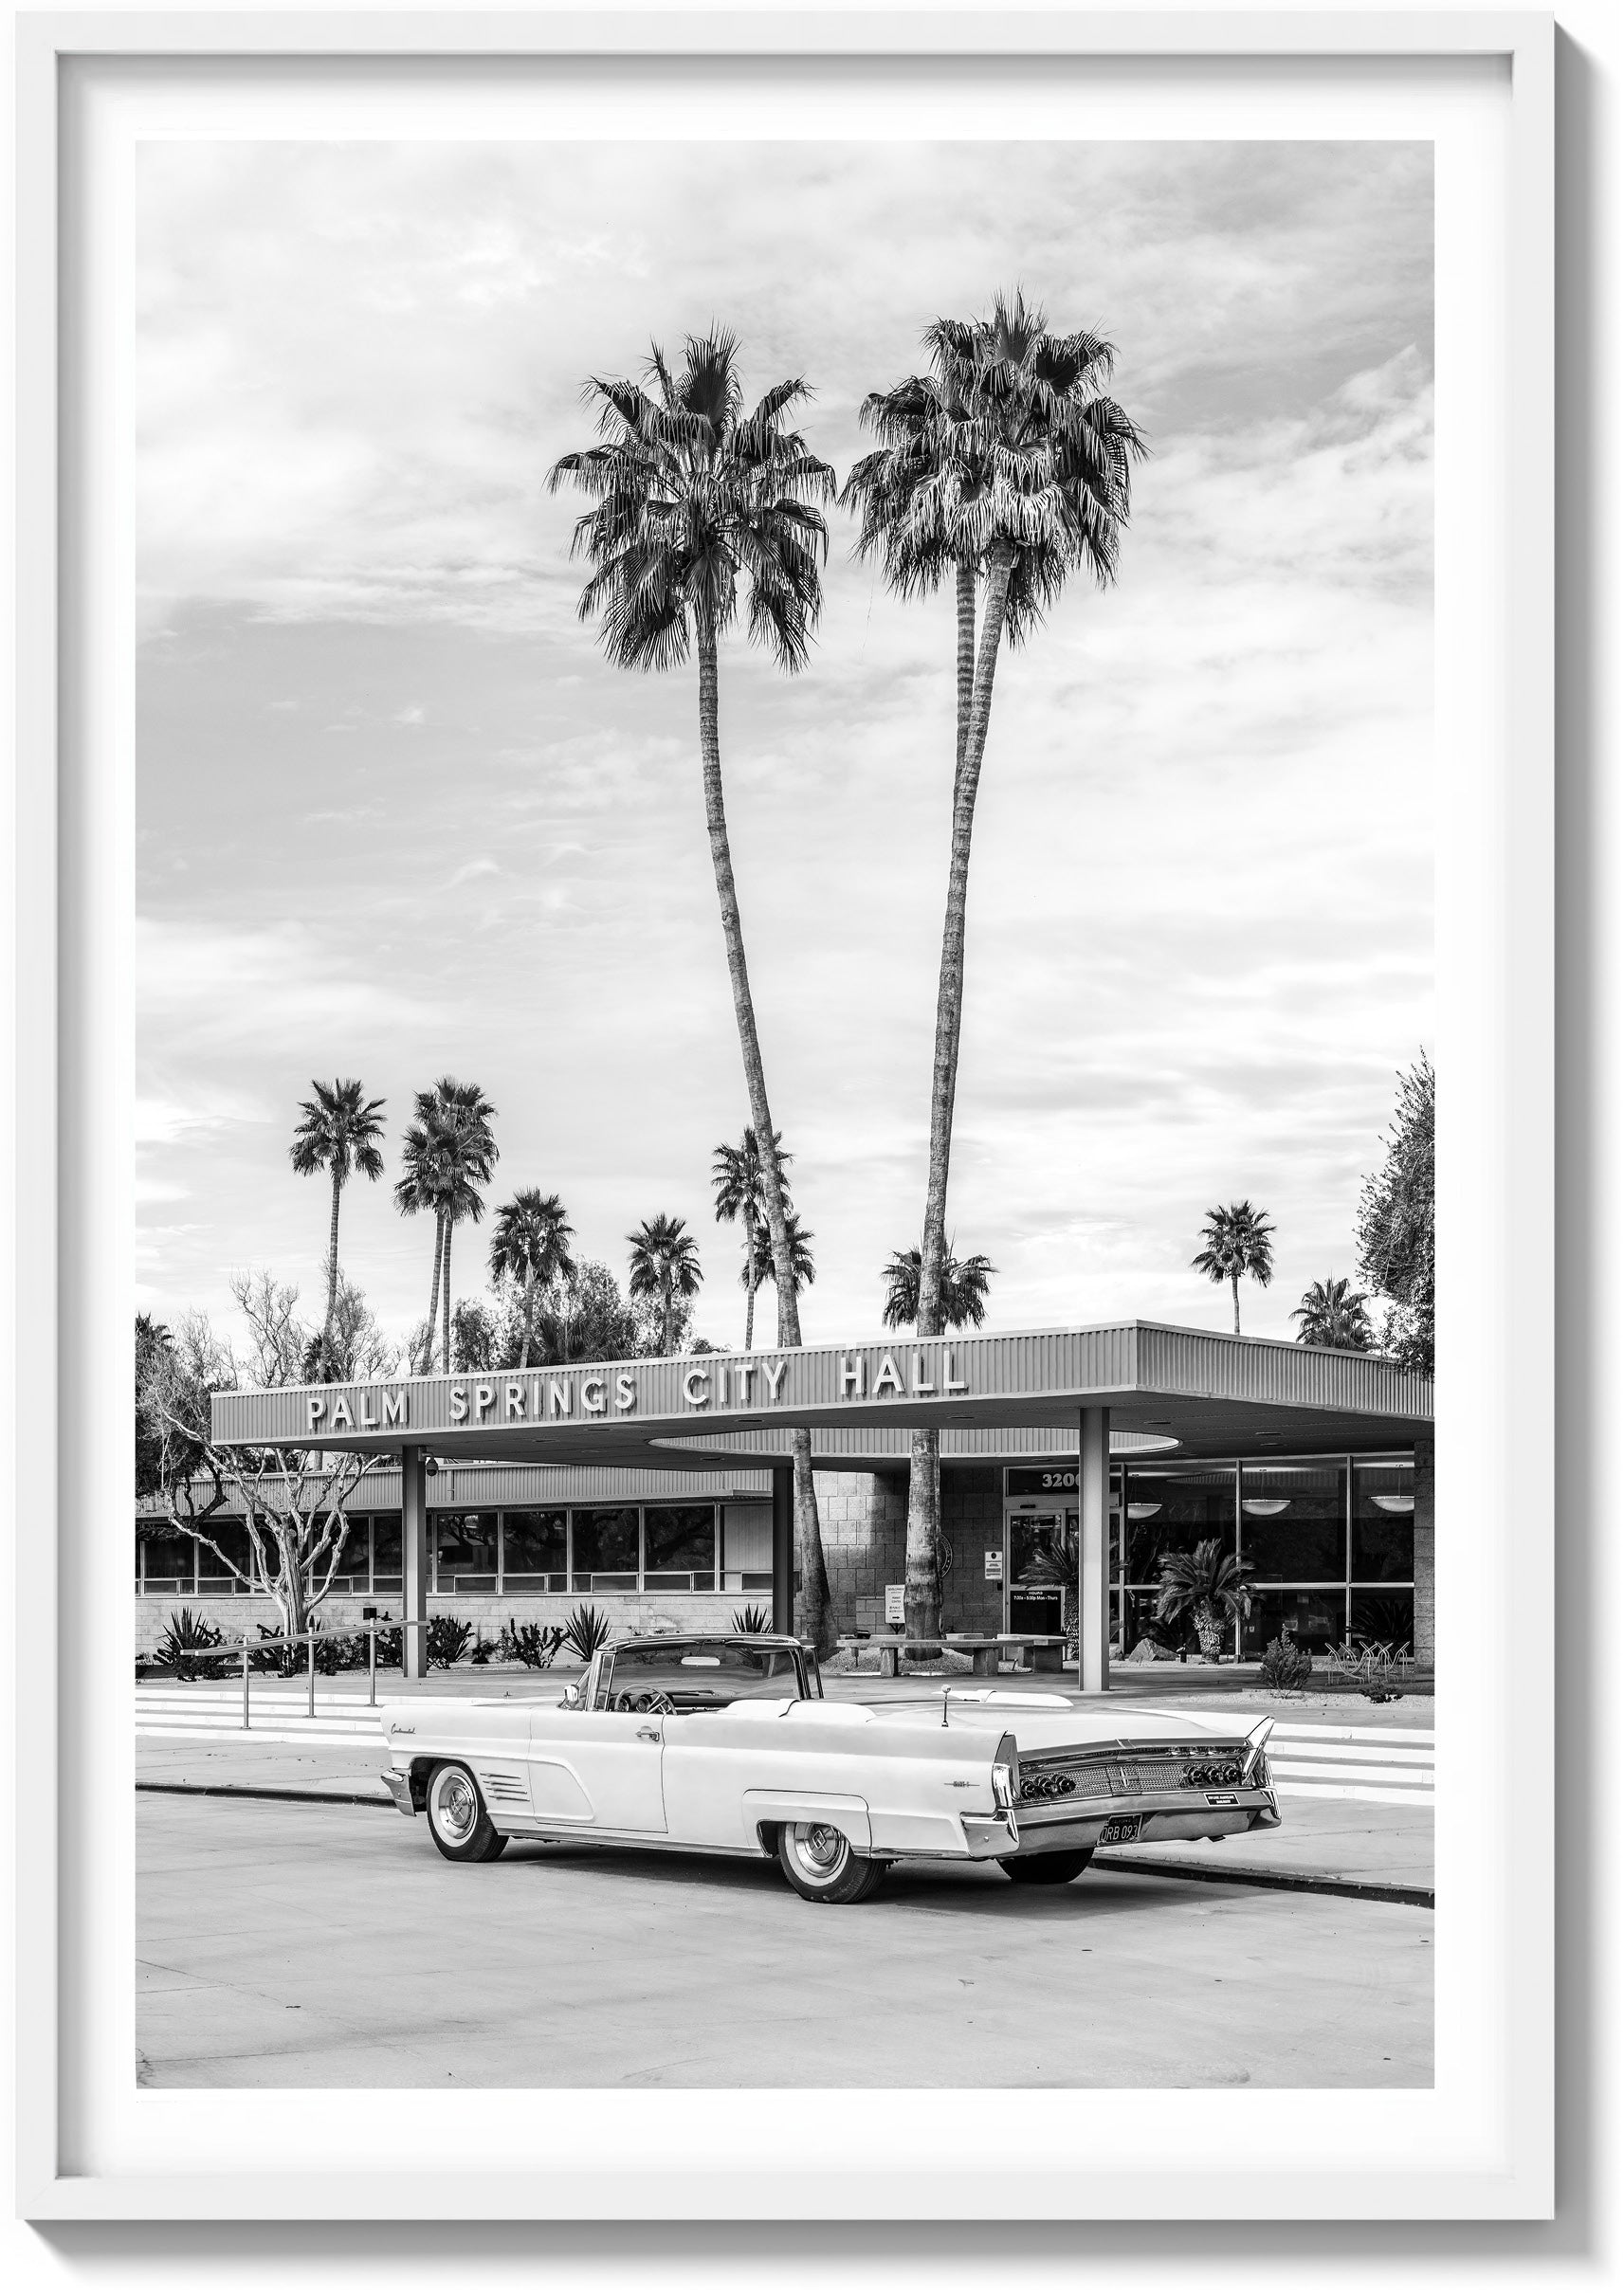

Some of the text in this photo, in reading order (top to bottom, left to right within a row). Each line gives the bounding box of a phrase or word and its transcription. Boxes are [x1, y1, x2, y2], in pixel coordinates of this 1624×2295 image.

[307, 1350, 968, 1430] PALM SPRINGS CITY HALL
[1122, 1825, 1138, 1839] 093
